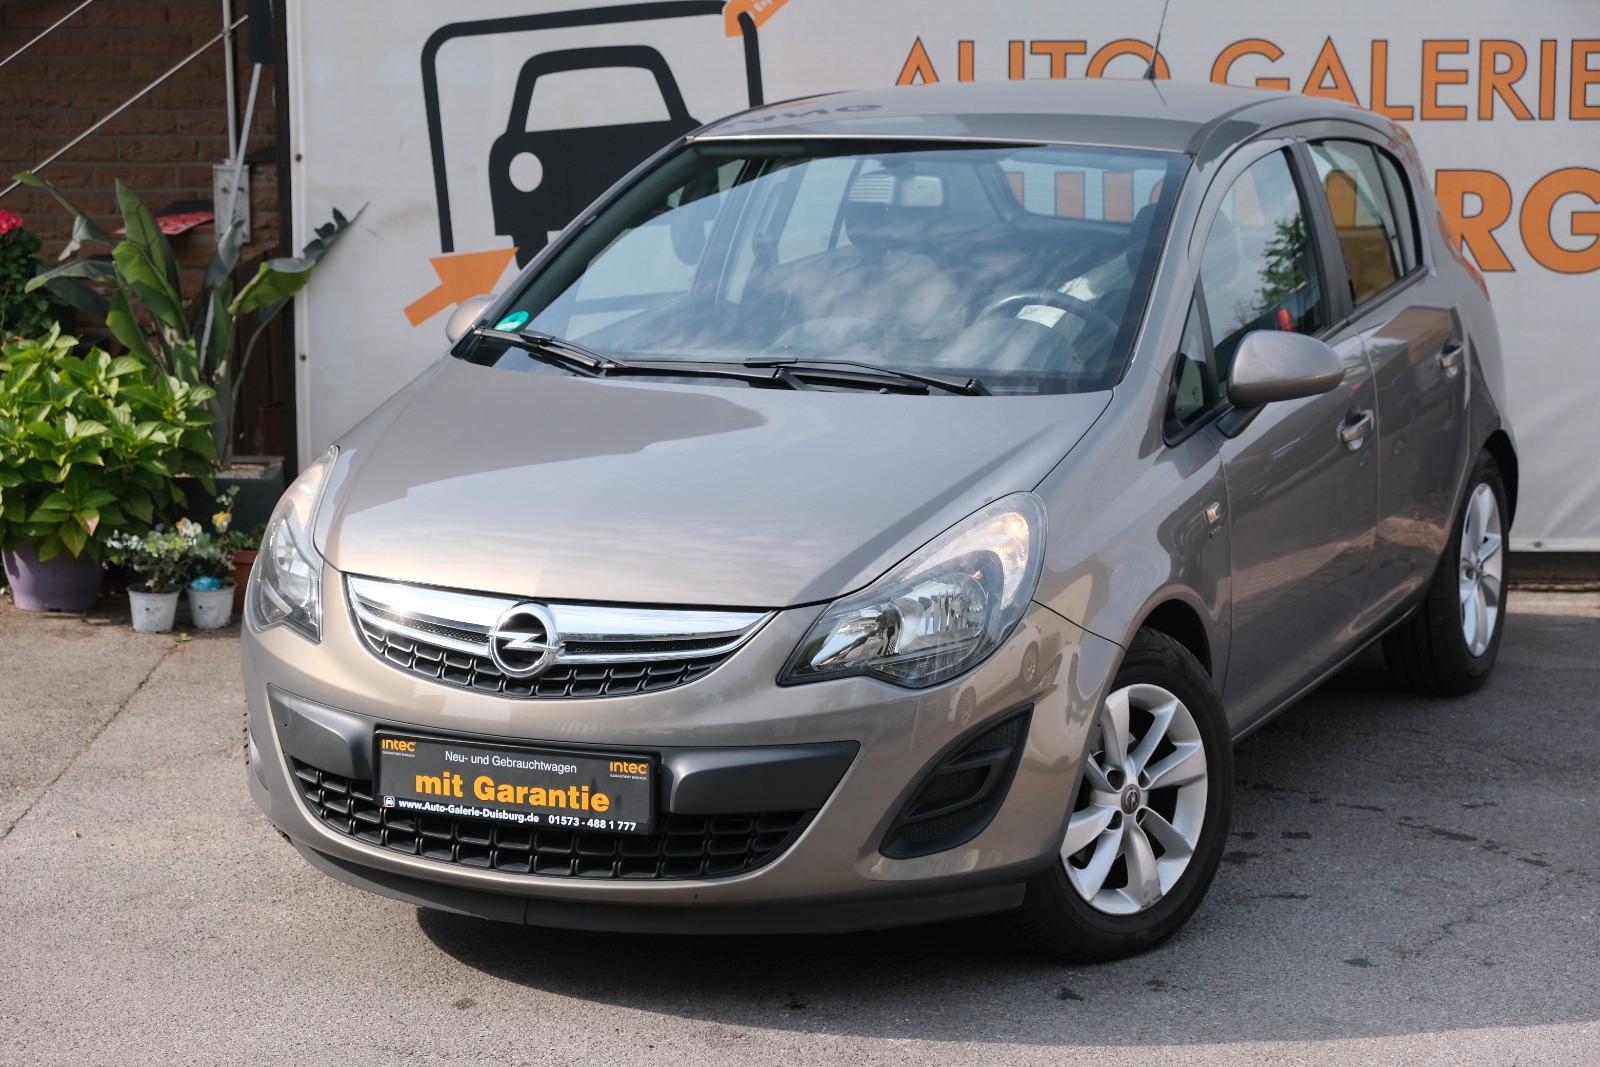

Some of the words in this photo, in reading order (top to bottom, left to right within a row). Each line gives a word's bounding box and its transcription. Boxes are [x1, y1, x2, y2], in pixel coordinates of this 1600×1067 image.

[1210, 36, 1600, 121] GALERIE
[445, 751, 468, 763] Neu-
[471, 755, 489, 765] und
[492, 756, 577, 774] Gebrauchtwagen
[415, 772, 464, 798] mit
[473, 776, 610, 812] Garantie
[398, 800, 540, 824] www.Auto-Galerie-Duisburg.de
[548, 815, 580, 827] 01573
[587, 819, 607, 829] 488
[609, 820, 614, 830] 1
[617, 821, 637, 832] 777
